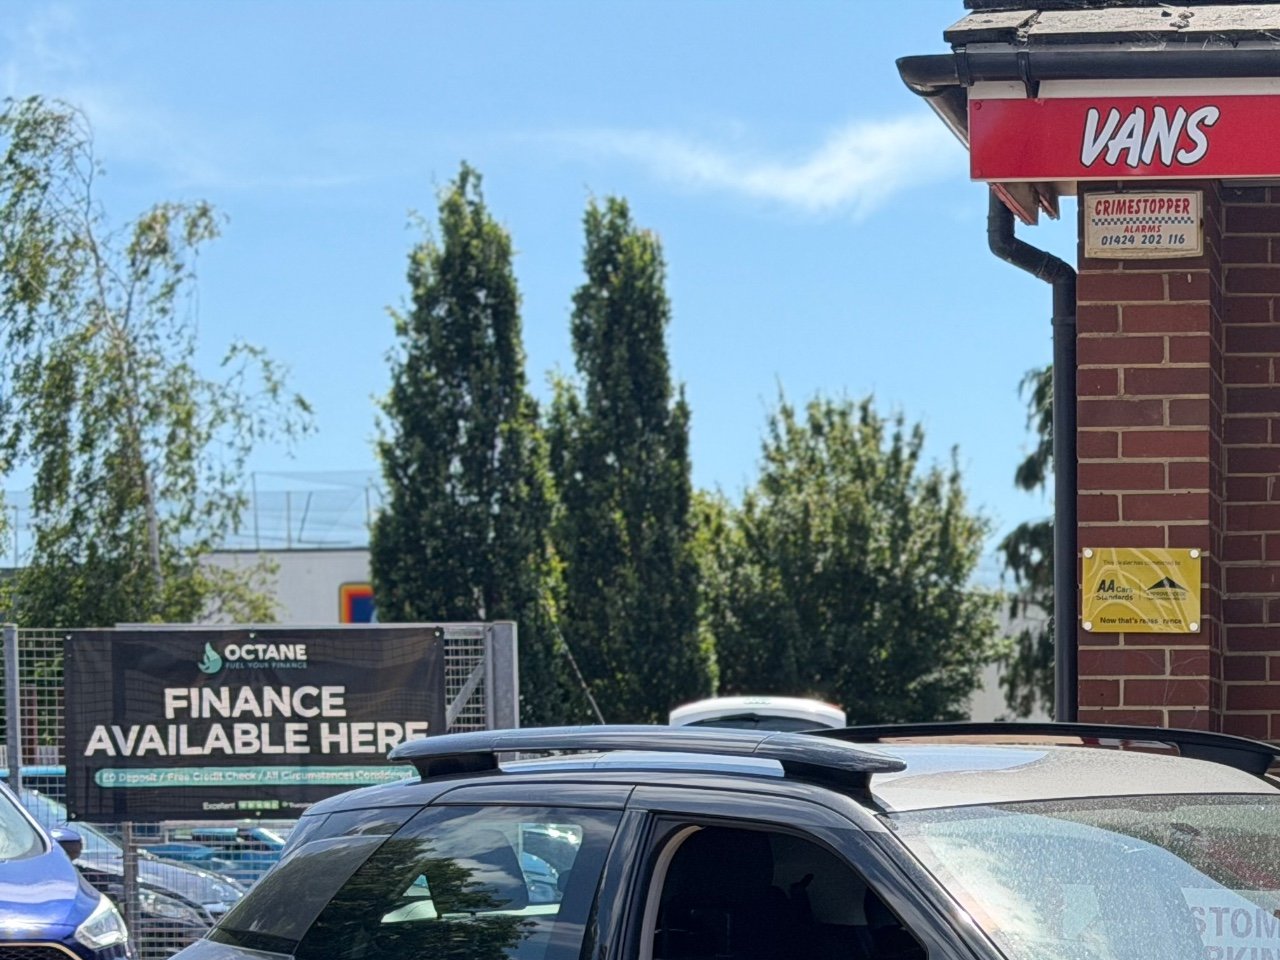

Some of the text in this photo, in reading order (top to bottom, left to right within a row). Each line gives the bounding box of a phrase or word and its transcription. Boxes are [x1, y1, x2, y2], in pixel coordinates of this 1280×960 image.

[1080, 105, 1220, 168] VANS
[1094, 198, 1191, 217] CRIMESTOPPER
[1123, 224, 1163, 235] ALARMS
[1101, 233, 1186, 246] 01424 202 116
[1097, 579, 1115, 593] AA
[1100, 617, 1116, 625] Now
[224, 643, 308, 661] OCTANE
[164, 686, 346, 720] FINANCE
[84, 722, 309, 757] AVAILABLE
